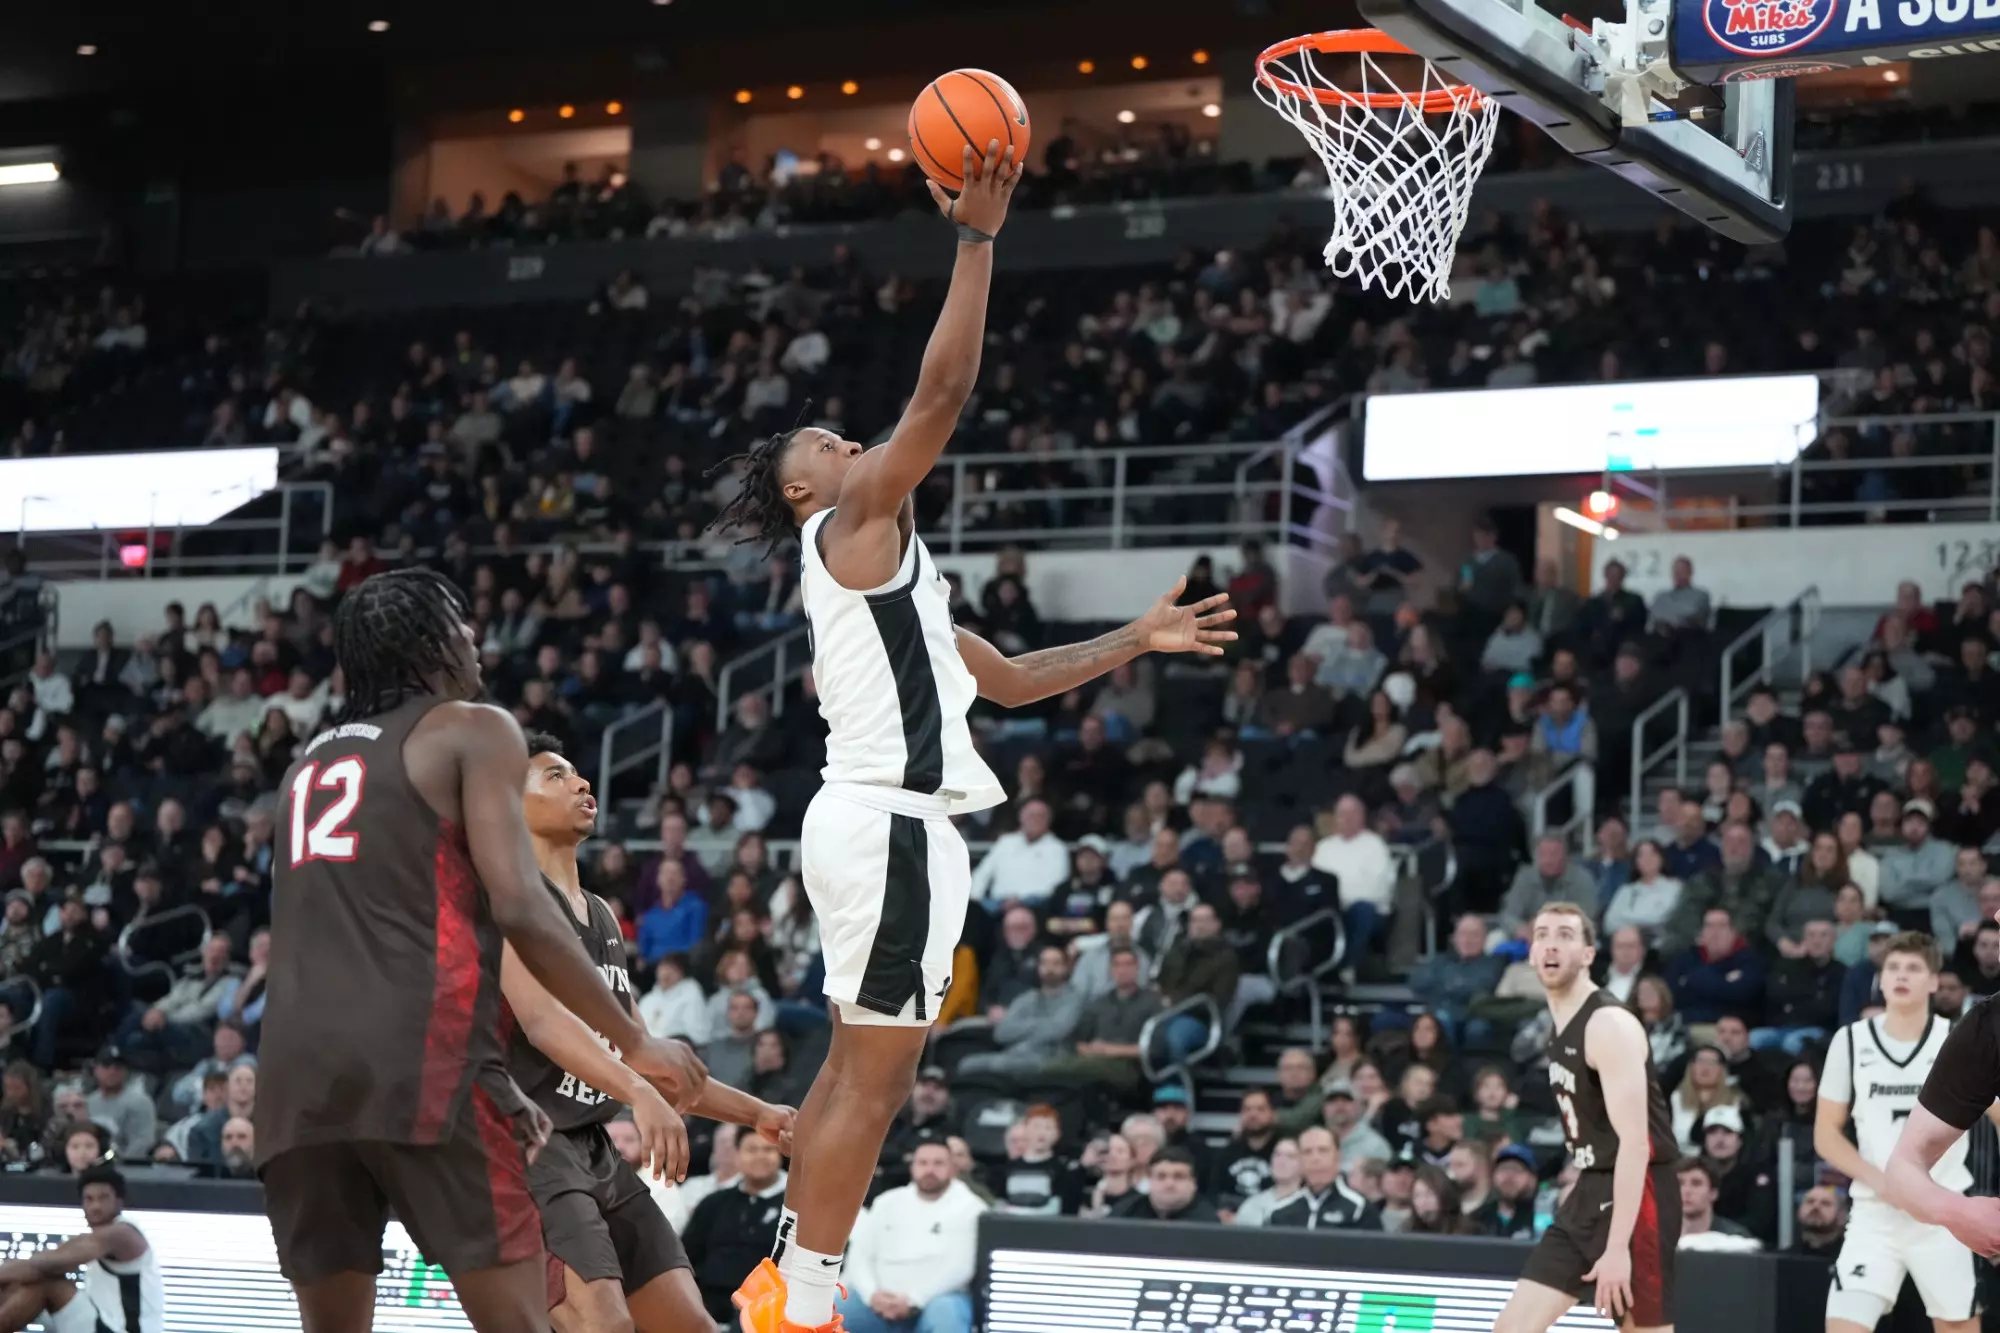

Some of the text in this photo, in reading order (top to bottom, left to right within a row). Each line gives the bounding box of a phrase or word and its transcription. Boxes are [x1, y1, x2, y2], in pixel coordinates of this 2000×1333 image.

[1725, 2, 1817, 35] Mike's
[1750, 33, 1786, 47] SUBS
[289, 755, 367, 870] 12
